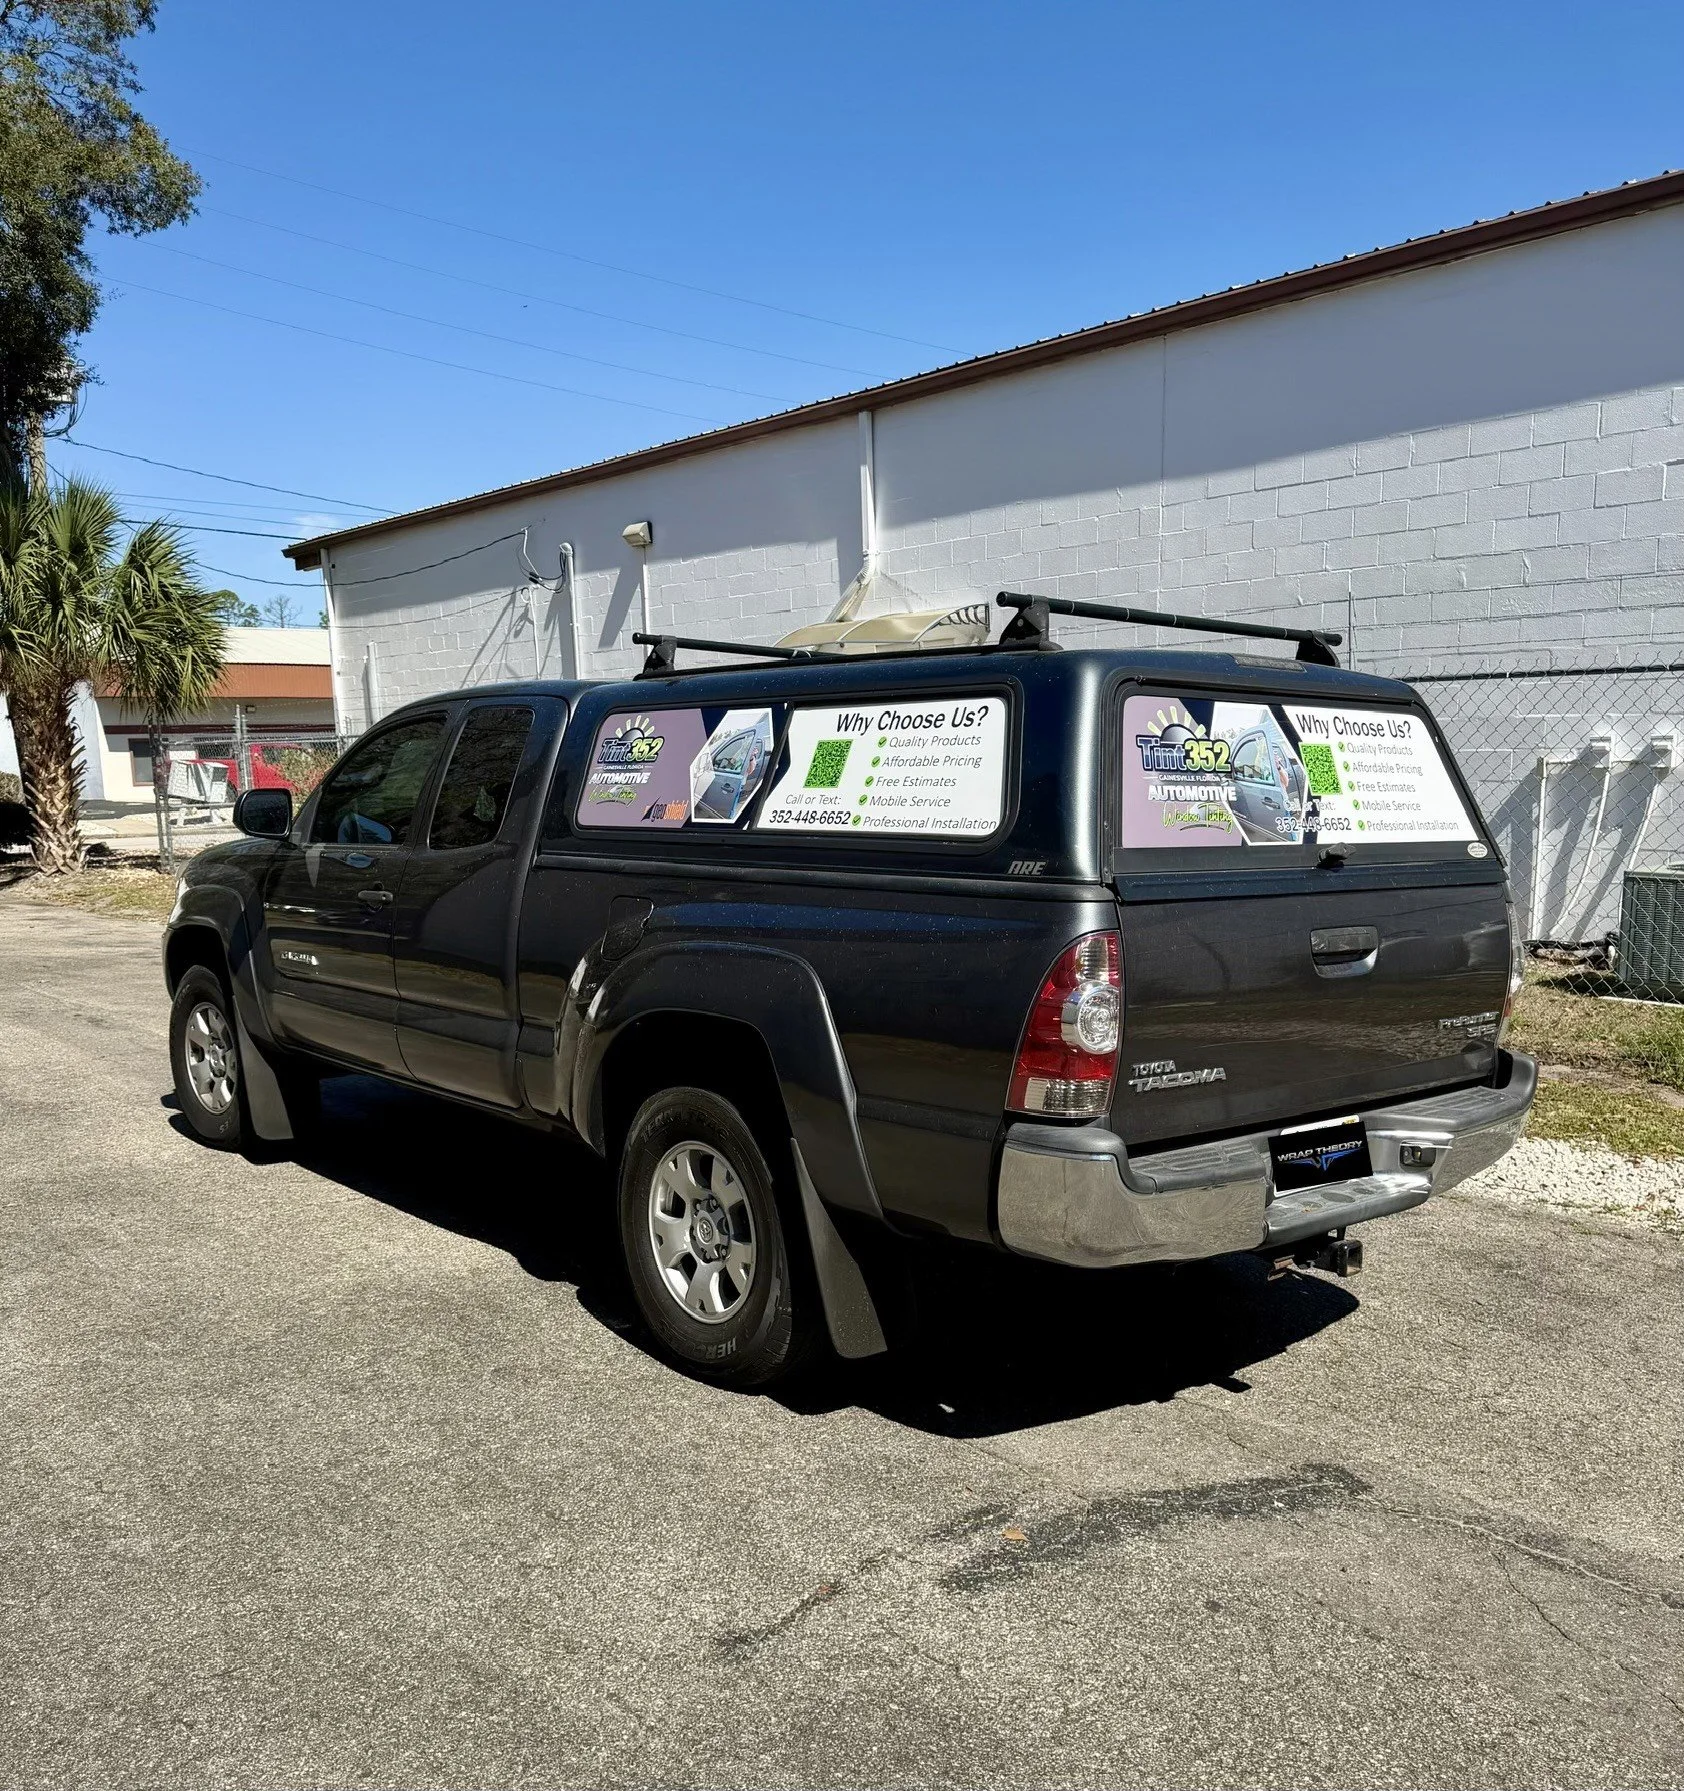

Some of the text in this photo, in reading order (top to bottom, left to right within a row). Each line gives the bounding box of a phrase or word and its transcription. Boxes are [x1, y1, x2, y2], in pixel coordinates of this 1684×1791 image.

[836, 705, 989, 736] Why Choose Us?
[1296, 713, 1412, 739] Why Choose Us?
[889, 735, 982, 749] Quality Products
[1347, 742, 1413, 756] Quality Products
[1136, 735, 1233, 772] Tint352
[881, 755, 983, 769] Affordable Pricing
[1352, 762, 1423, 776] Affordable Pricing
[589, 772, 651, 784] AUTOMOTIVE
[875, 776, 957, 787] Free Estimates
[1158, 774, 1195, 782] GAINESVILLE
[1148, 785, 1237, 801] AUTOMOTIVE
[1356, 781, 1416, 793] Free Estimates
[785, 794, 842, 805] Call or Text:
[869, 796, 951, 808] Mobile Service
[1362, 800, 1421, 811] Mobile Service
[769, 809, 851, 825] 352-448-6652
[863, 816, 997, 830] Professional Installation
[1275, 817, 1352, 832] 352-448-6652
[1367, 820, 1459, 832] Professional Installation
[1132, 1060, 1177, 1077] TOYOTA
[1127, 1067, 1227, 1093] TACOMA
[1277, 1140, 1363, 1162] WRAP THEORY
